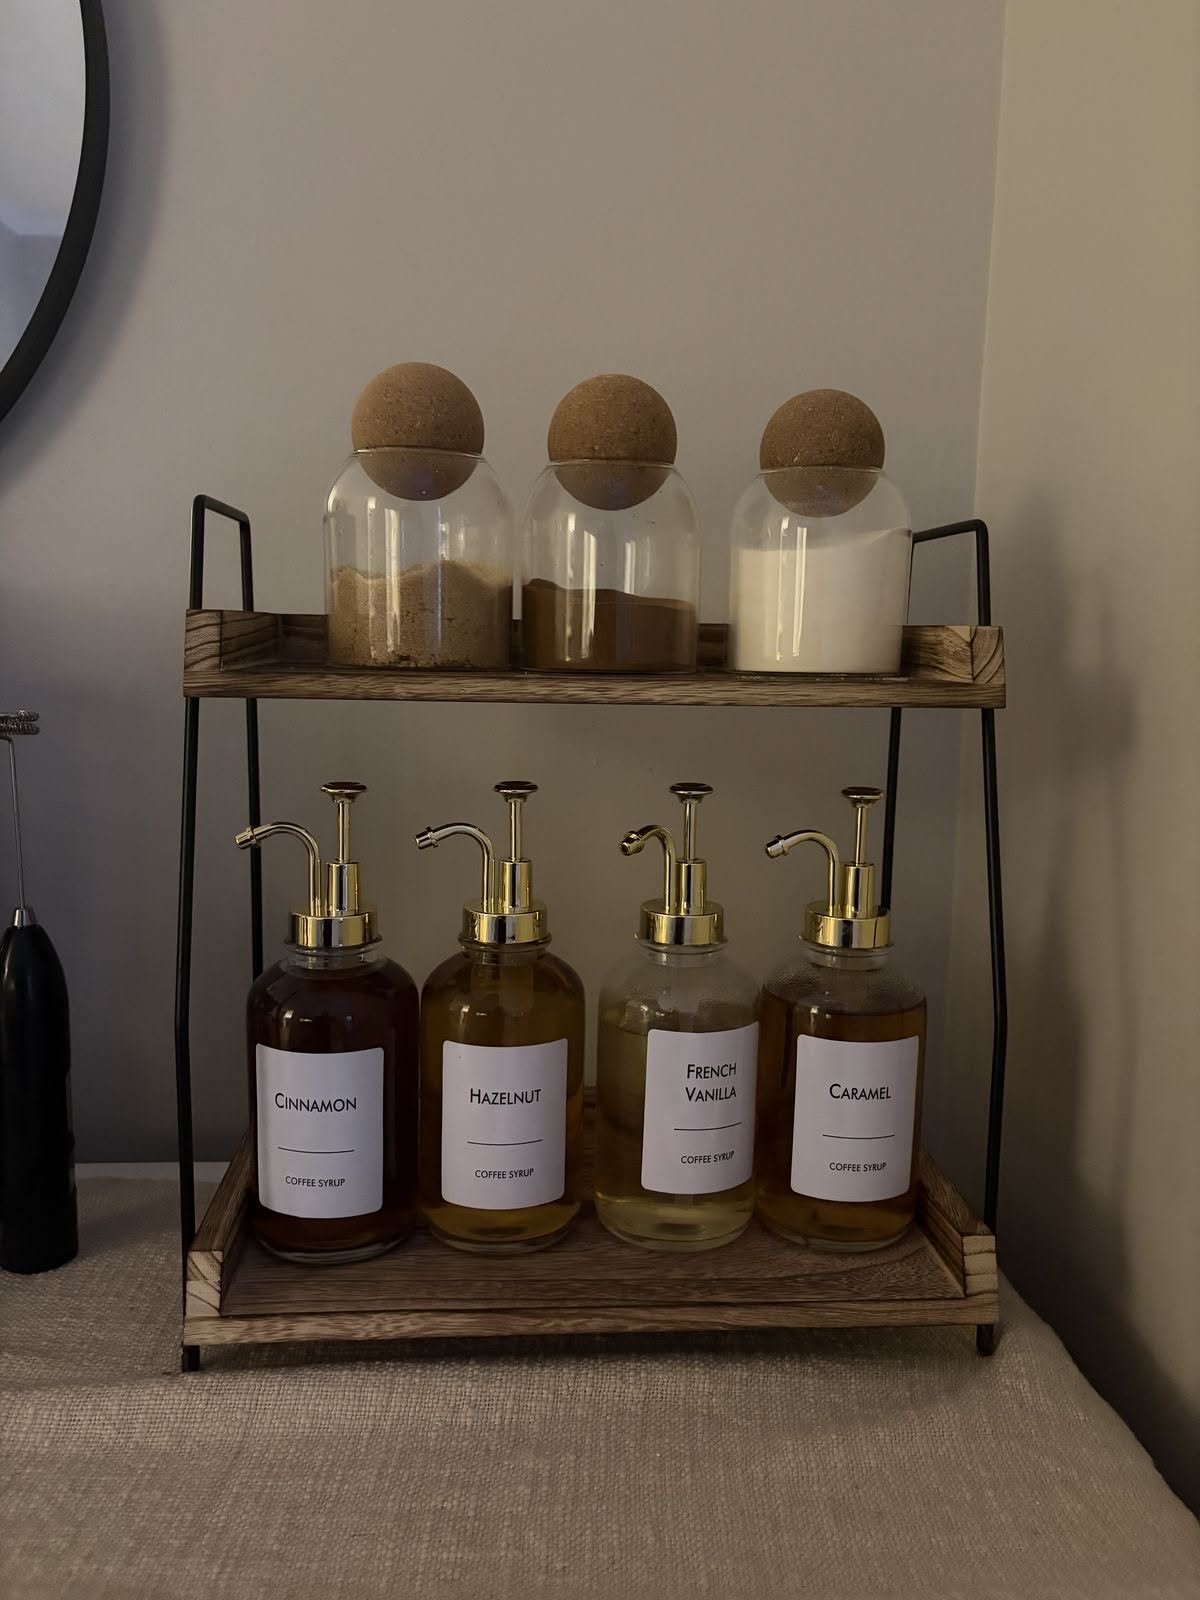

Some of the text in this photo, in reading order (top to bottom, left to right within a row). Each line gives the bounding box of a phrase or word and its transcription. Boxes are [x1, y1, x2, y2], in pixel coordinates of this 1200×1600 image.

[687, 1063, 737, 1080] FRENCH
[469, 1088, 542, 1105] HAZELNUT
[685, 1086, 737, 1102] VANILLA
[829, 1083, 892, 1101] CARAMEL
[274, 1092, 357, 1113] CINNAMON
[680, 1150, 735, 1165] COFFEE SYRUP
[474, 1167, 535, 1179] COFFEE SYRUP
[829, 1162, 887, 1173] COFFEE SYRUP
[285, 1175, 346, 1188] COFFEE SYRUP
